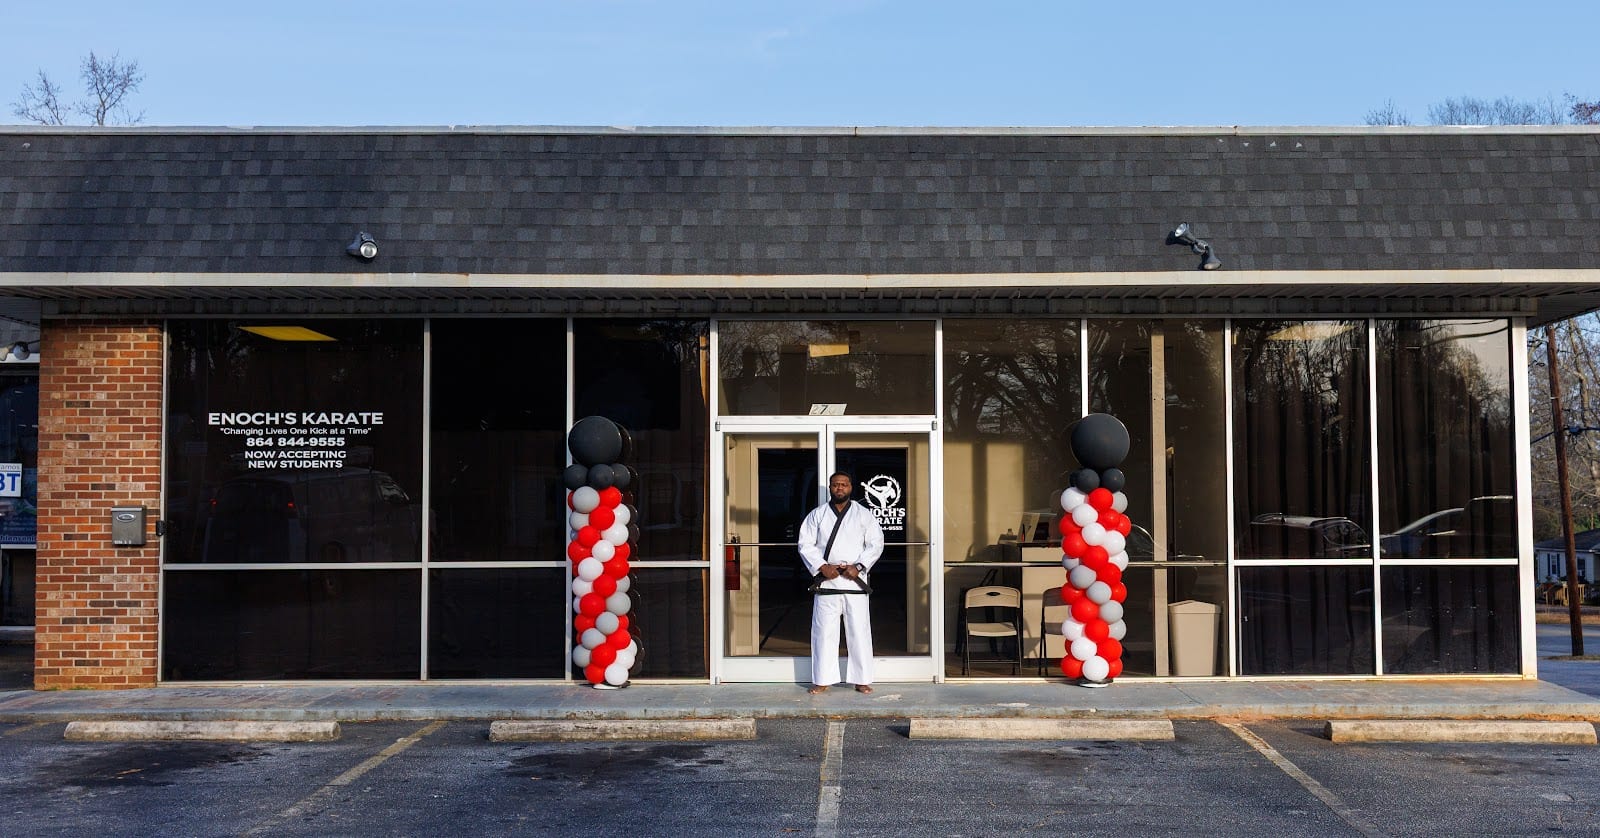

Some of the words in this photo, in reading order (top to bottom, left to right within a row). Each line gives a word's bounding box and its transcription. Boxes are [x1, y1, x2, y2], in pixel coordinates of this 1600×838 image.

[208, 412, 297, 425] ENOCH'S
[302, 412, 384, 425] KARATE
[220, 427, 264, 436] "Changing
[265, 427, 288, 435] Lives
[289, 427, 308, 435] One
[309, 427, 328, 435] Kick
[347, 427, 372, 435] Time"
[246, 437, 274, 447] 864
[277, 437, 346, 447] 844-9555
[244, 451, 276, 459] NOW
[278, 450, 347, 459] ACCEPTING
[248, 460, 278, 469] NEW
[279, 460, 343, 468] STUDENTS
[869, 508, 905, 517] OCH'S
